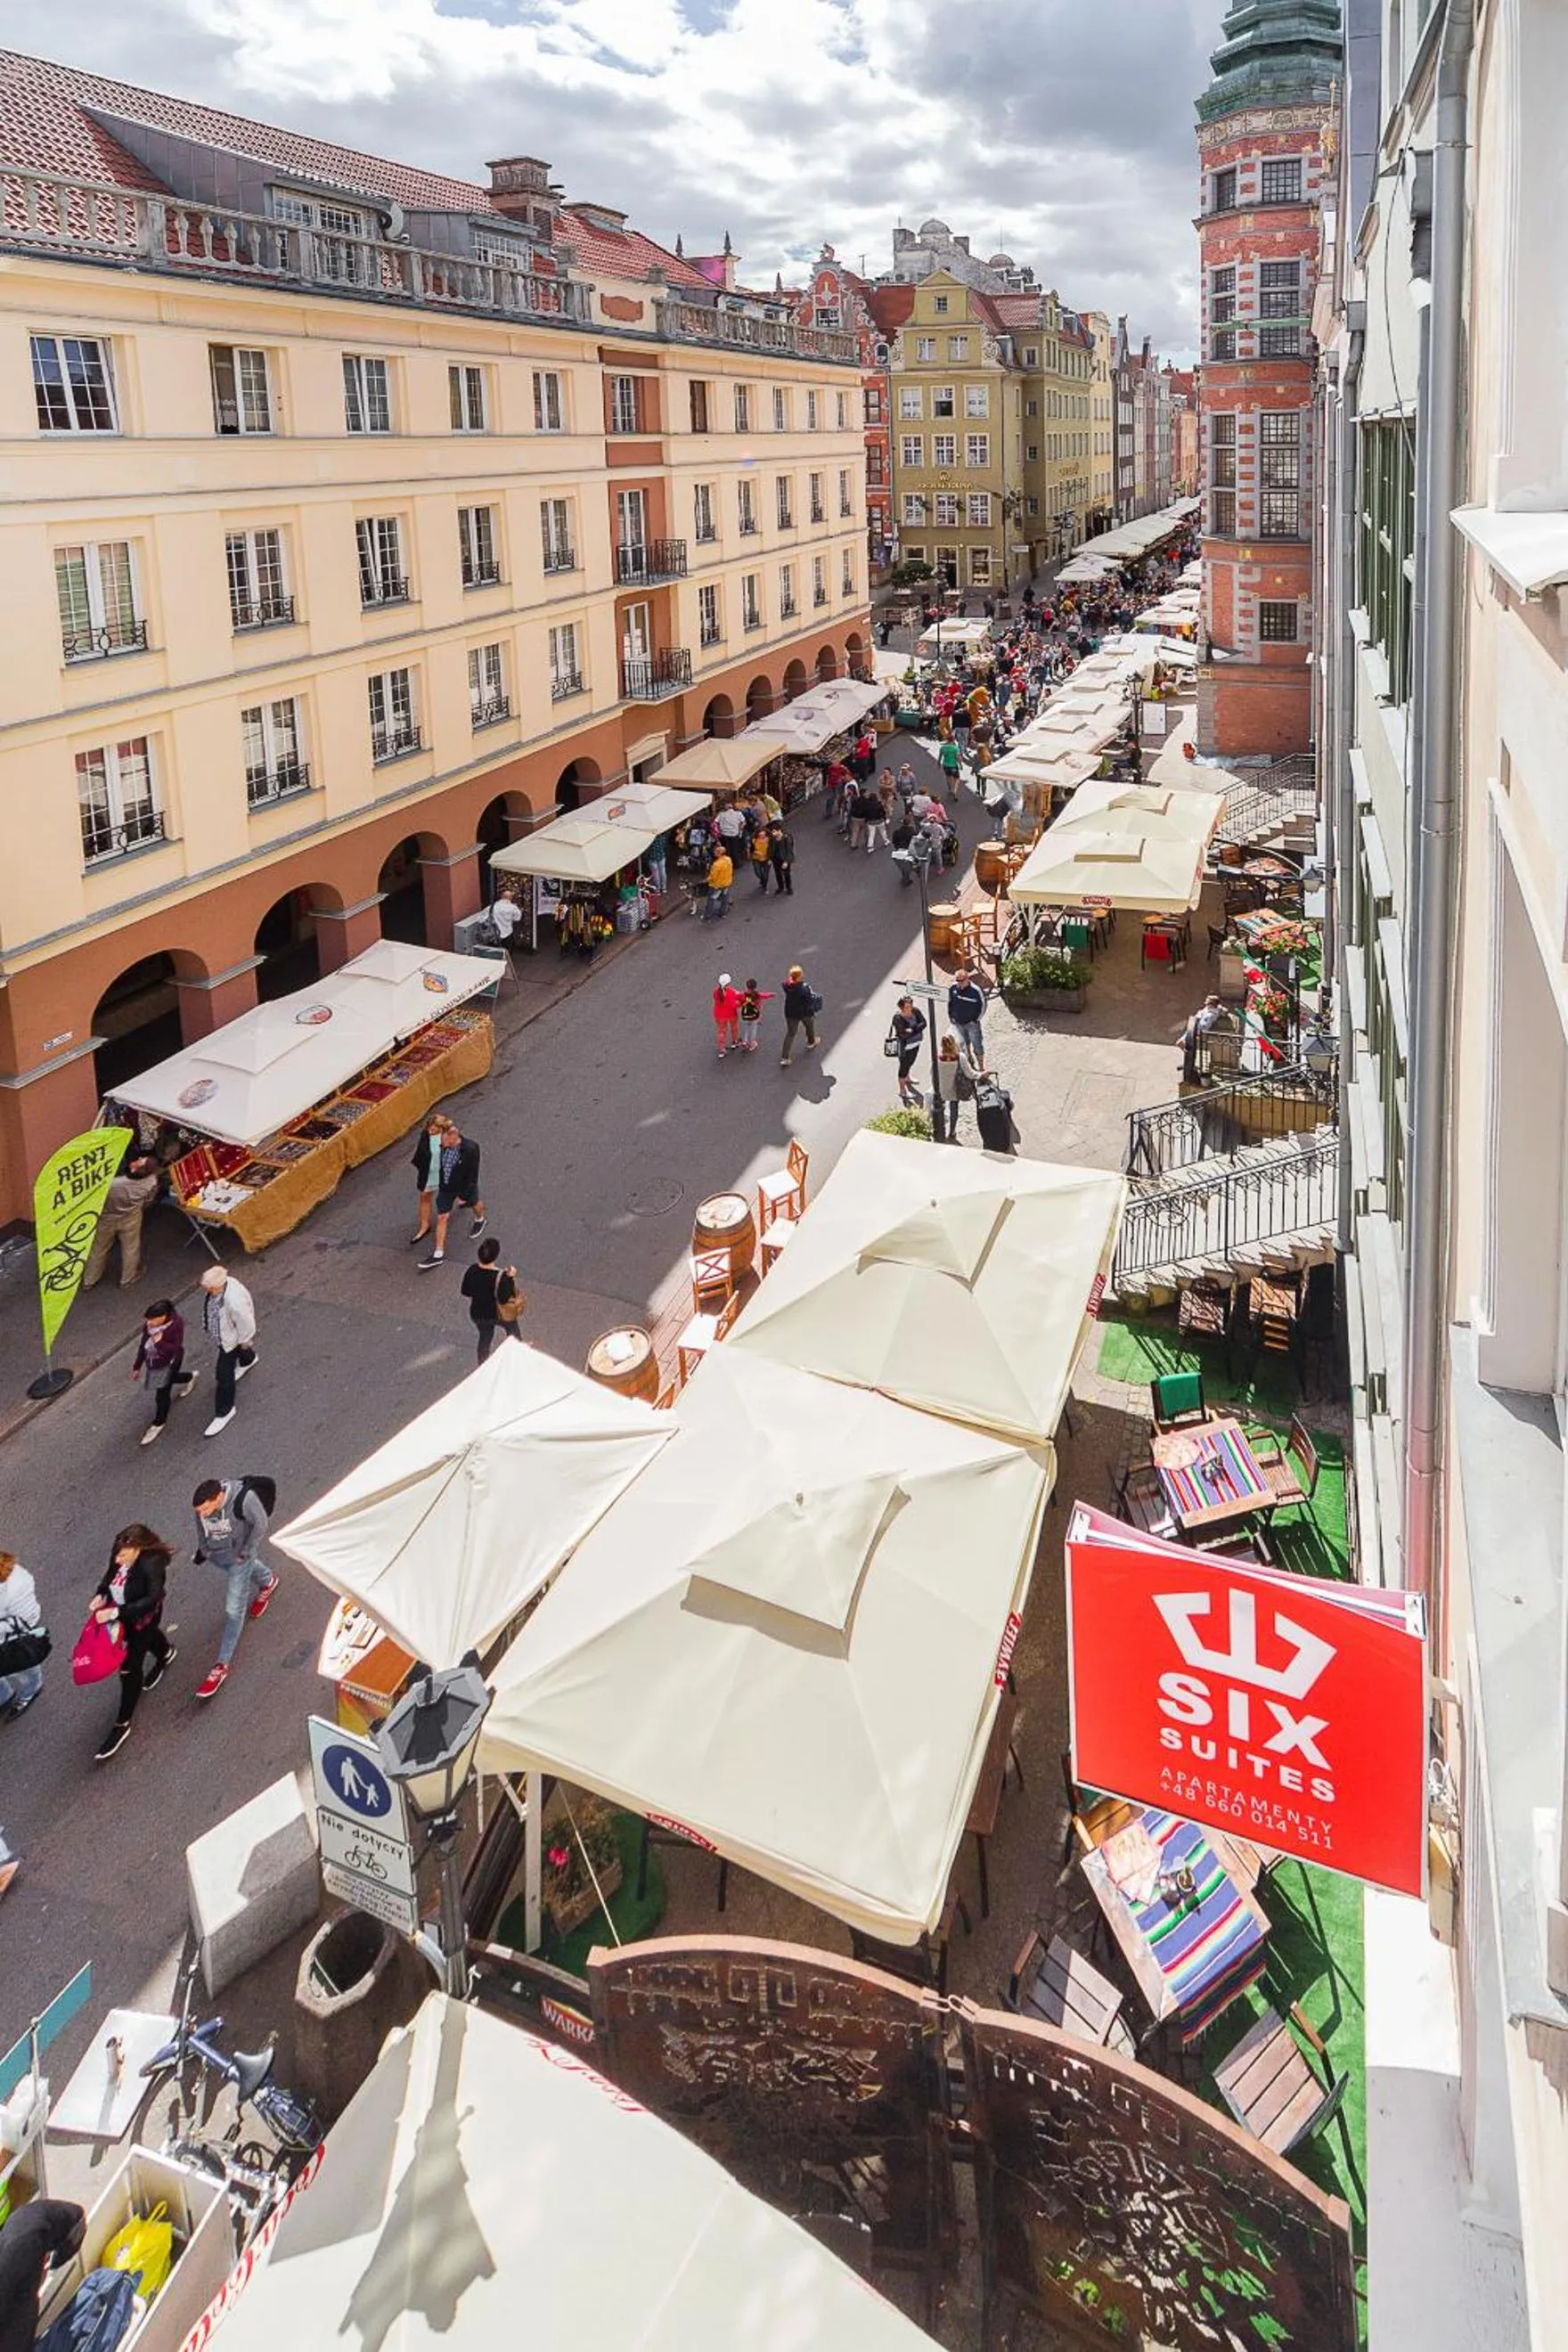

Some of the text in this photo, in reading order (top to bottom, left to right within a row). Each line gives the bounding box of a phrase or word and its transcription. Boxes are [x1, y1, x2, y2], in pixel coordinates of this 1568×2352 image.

[53, 1158, 114, 1210] A BIKE
[57, 1141, 110, 1186] RENT
[1157, 1671, 1333, 1772] SIX
[1159, 1727, 1335, 1803] SUITES
[1160, 1767, 1333, 1834] APARTAMENTY
[1160, 1782, 1333, 1850] +48 660 014 511
[321, 1813, 404, 1860] Nie dotyczy
